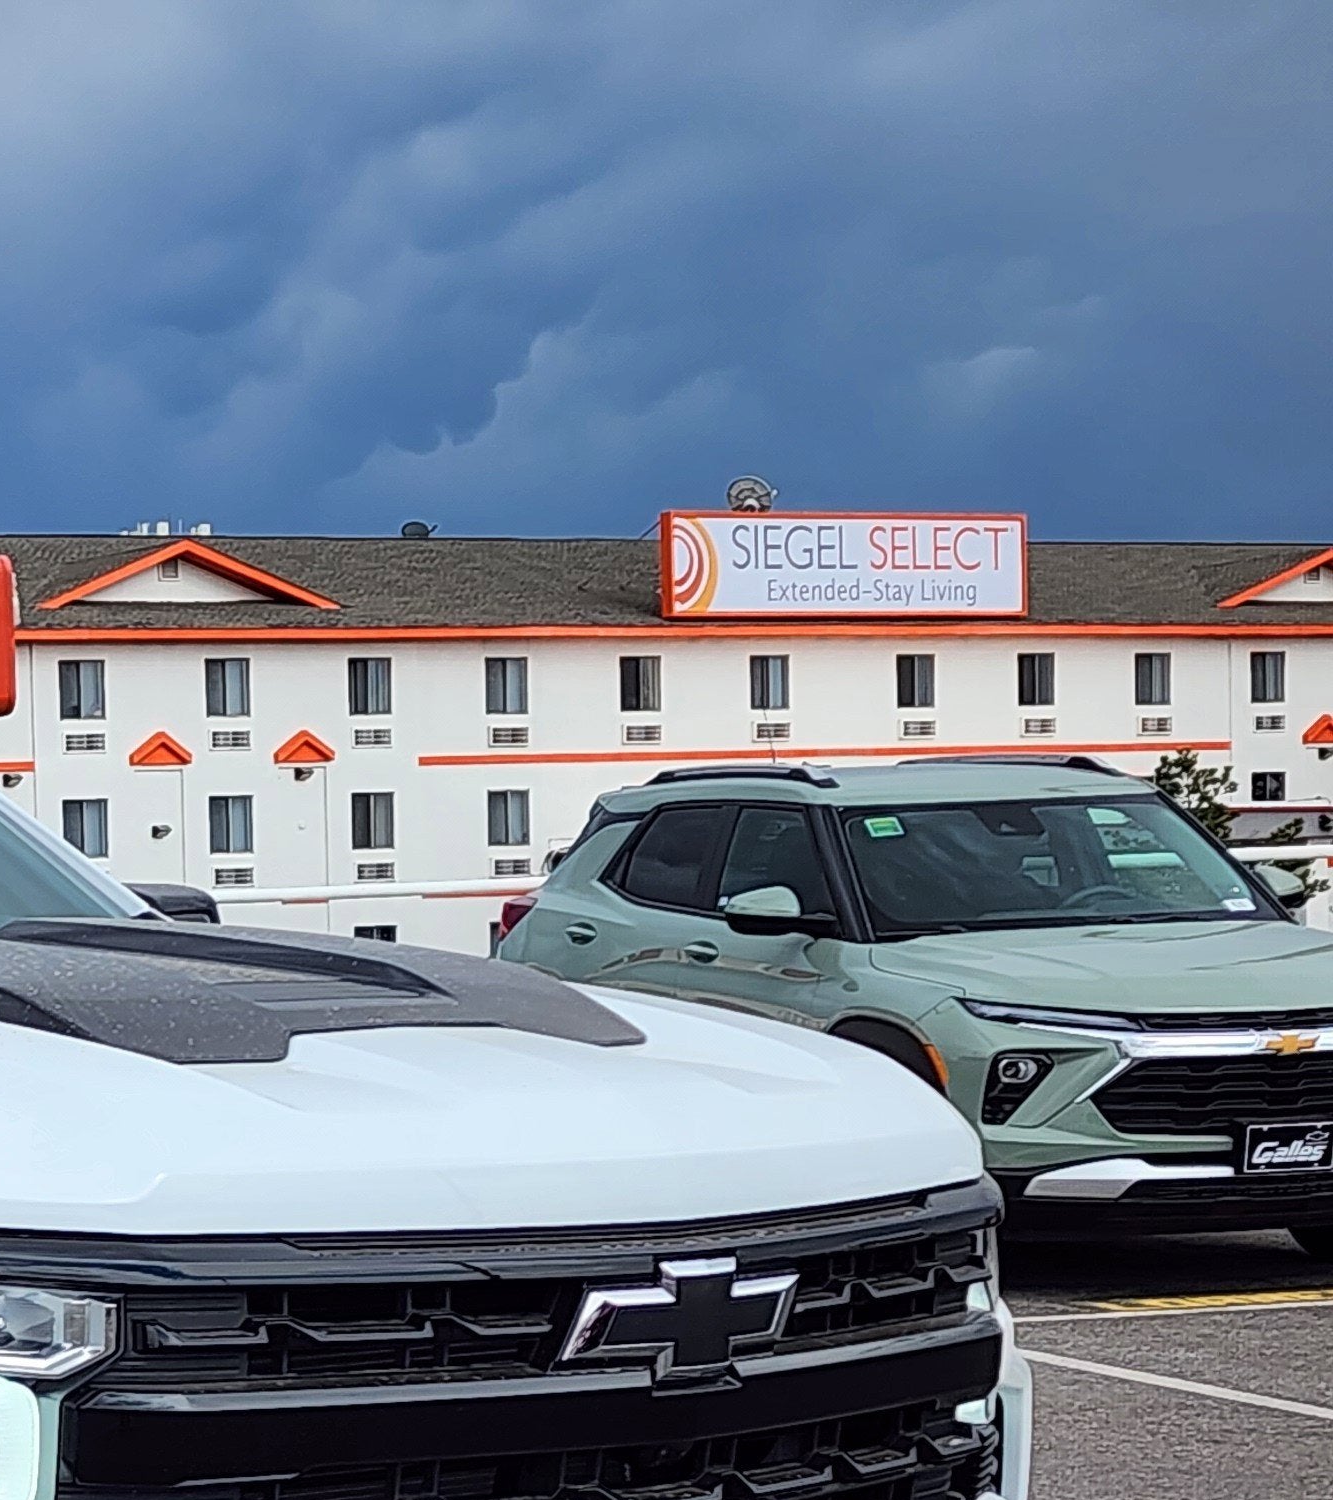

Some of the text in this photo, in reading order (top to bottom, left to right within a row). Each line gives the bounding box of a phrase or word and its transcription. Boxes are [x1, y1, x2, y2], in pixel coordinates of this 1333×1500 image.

[732, 524, 1010, 571] SIEGEL SELECT
[767, 577, 977, 606] Extended-Stay Living
